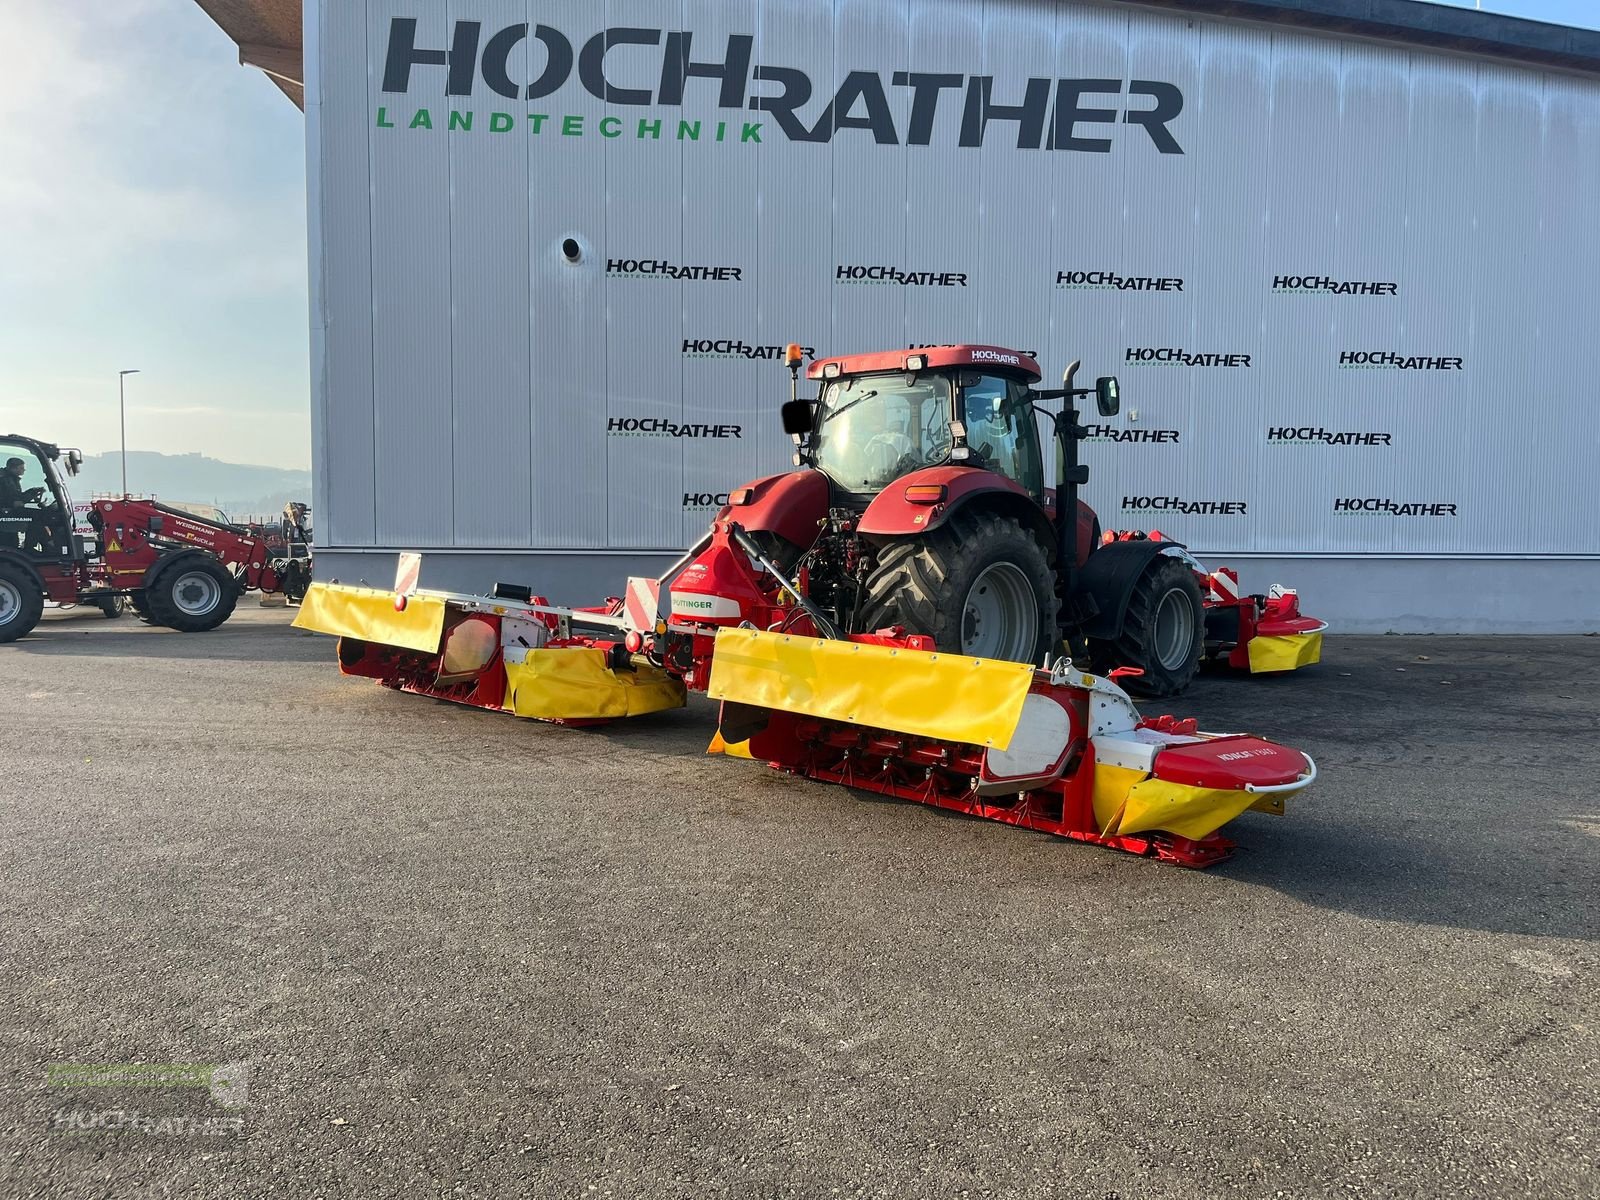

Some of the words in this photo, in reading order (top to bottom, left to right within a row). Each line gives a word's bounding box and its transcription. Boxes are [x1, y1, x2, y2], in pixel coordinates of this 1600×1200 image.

[382, 17, 1185, 154] HOCHRATHER
[377, 107, 763, 143] LANDTECHNIK
[607, 259, 742, 280] HOCHRATHER
[836, 265, 967, 286] HOCHRATHER
[1056, 271, 1184, 291] HOCHRATHER
[1272, 276, 1398, 295] HOCHRATHER
[1125, 348, 1251, 367] HOCHRATHER
[1340, 352, 1463, 370] HOCHRATHER
[607, 418, 742, 438] HOCHRATHER
[1268, 427, 1392, 446] HOCHRATHER
[1122, 497, 1247, 515] HOCHRATHER
[1334, 498, 1457, 516] HOCHRATHER
[175, 520, 215, 536] WEIDEMANN
